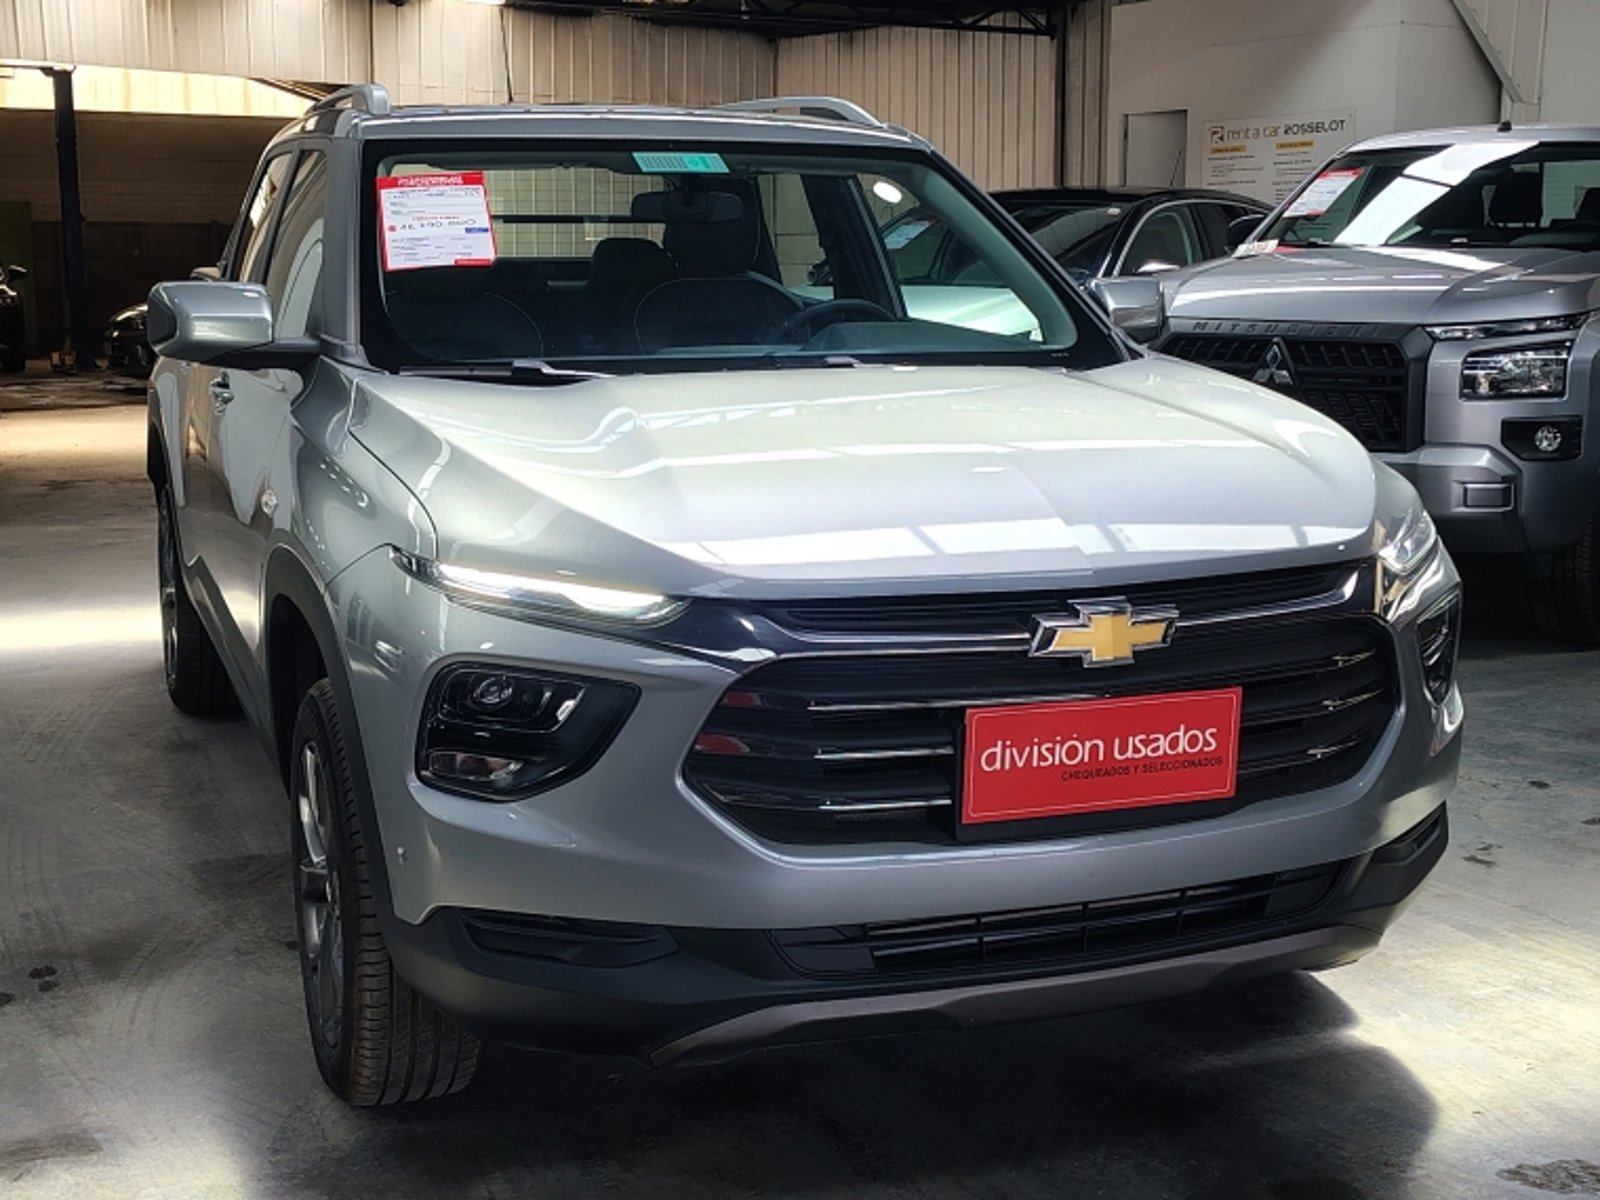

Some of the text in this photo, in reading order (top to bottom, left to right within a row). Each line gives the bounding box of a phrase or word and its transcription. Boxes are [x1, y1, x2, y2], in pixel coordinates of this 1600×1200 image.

[1226, 119, 1346, 141] rent a car ROSSELOT
[980, 724, 1218, 772] división usados
[1060, 755, 1223, 782] CHEQUEADOS Y SELECCIONADOS
